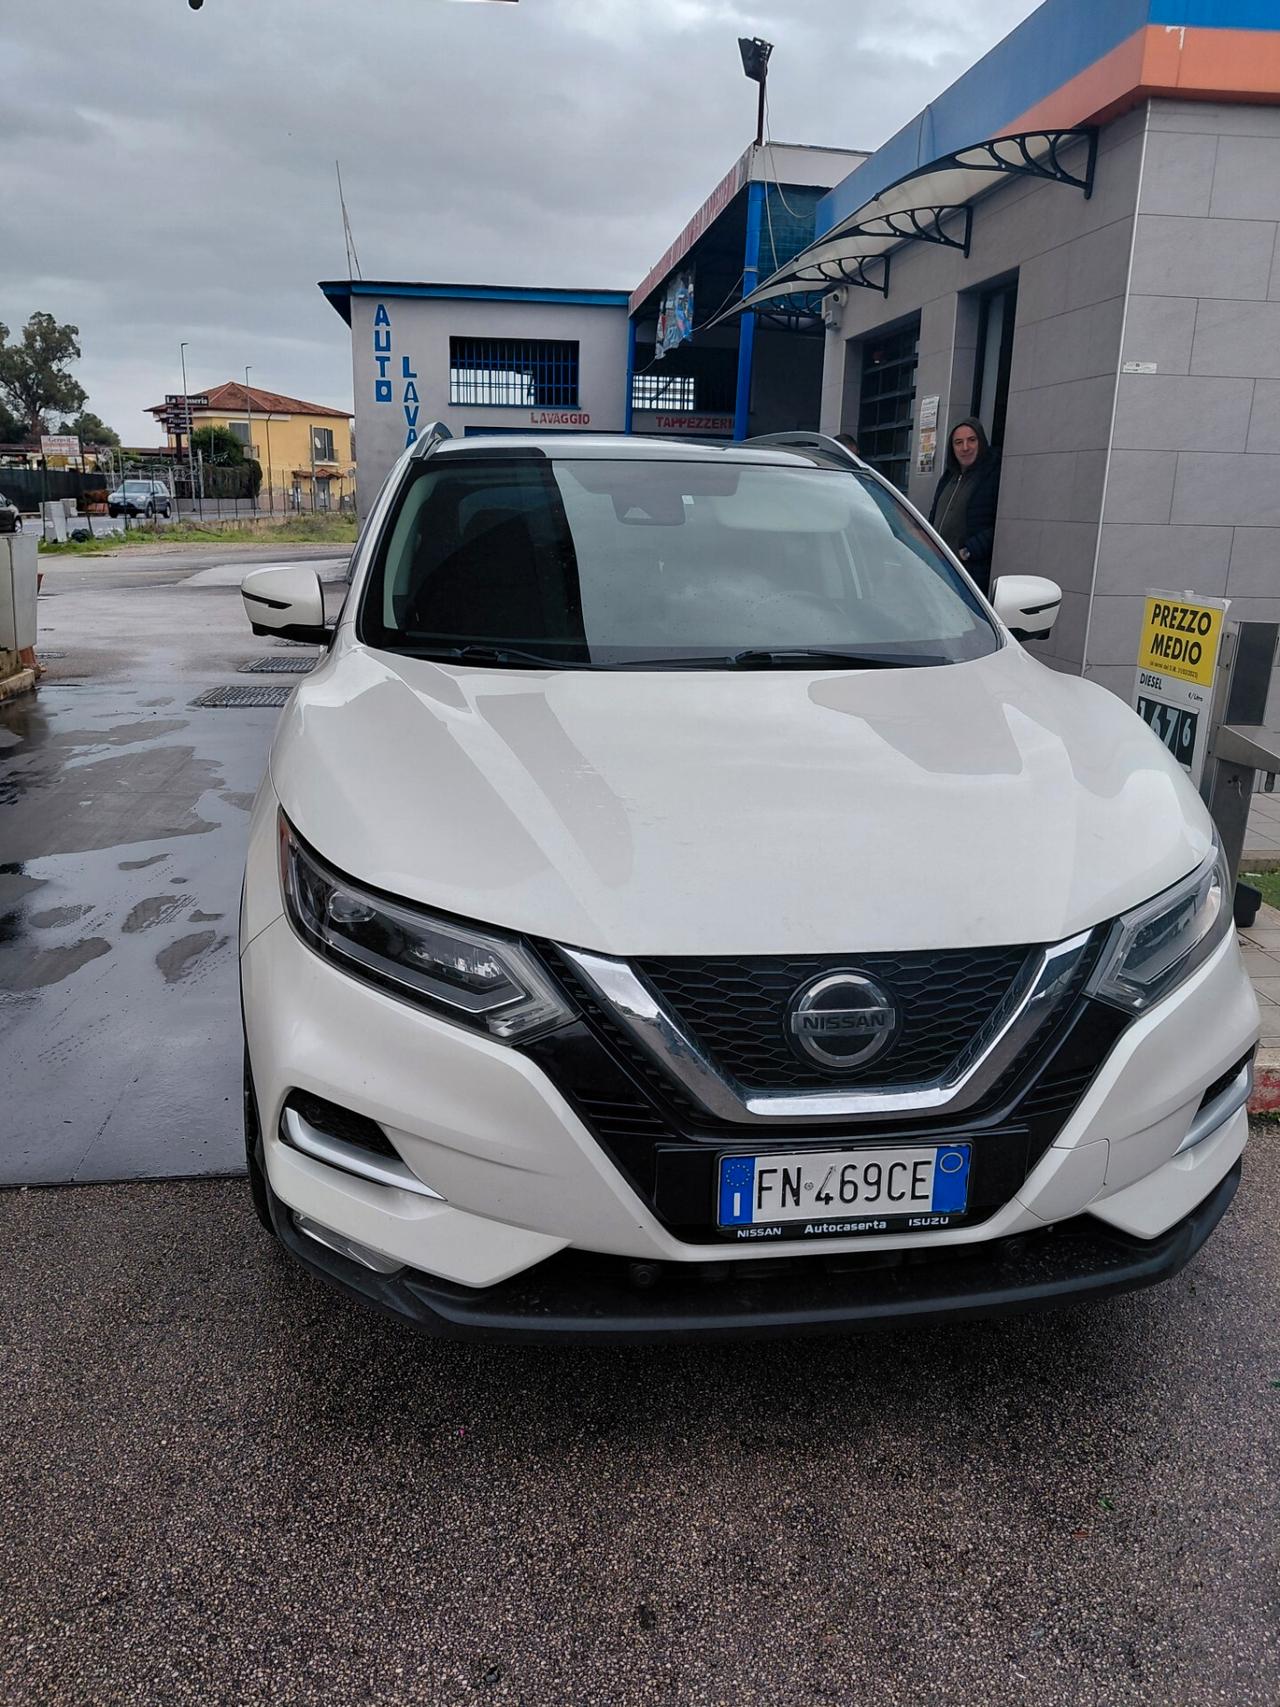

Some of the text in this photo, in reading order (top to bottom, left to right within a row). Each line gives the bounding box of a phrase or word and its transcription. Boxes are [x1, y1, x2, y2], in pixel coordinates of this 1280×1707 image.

[374, 303, 392, 402] AUTO
[531, 412, 590, 425] LAVAGGIO
[656, 416, 735, 429] TAPPEZZERI
[1151, 603, 1212, 636] PREZZO
[1150, 633, 1202, 665] MEDIO
[1140, 673, 1162, 690] DIESEL
[803, 1013, 885, 1030] NISSAN
[737, 1216, 950, 1238] NISSAN Autocaserta ISUZU
